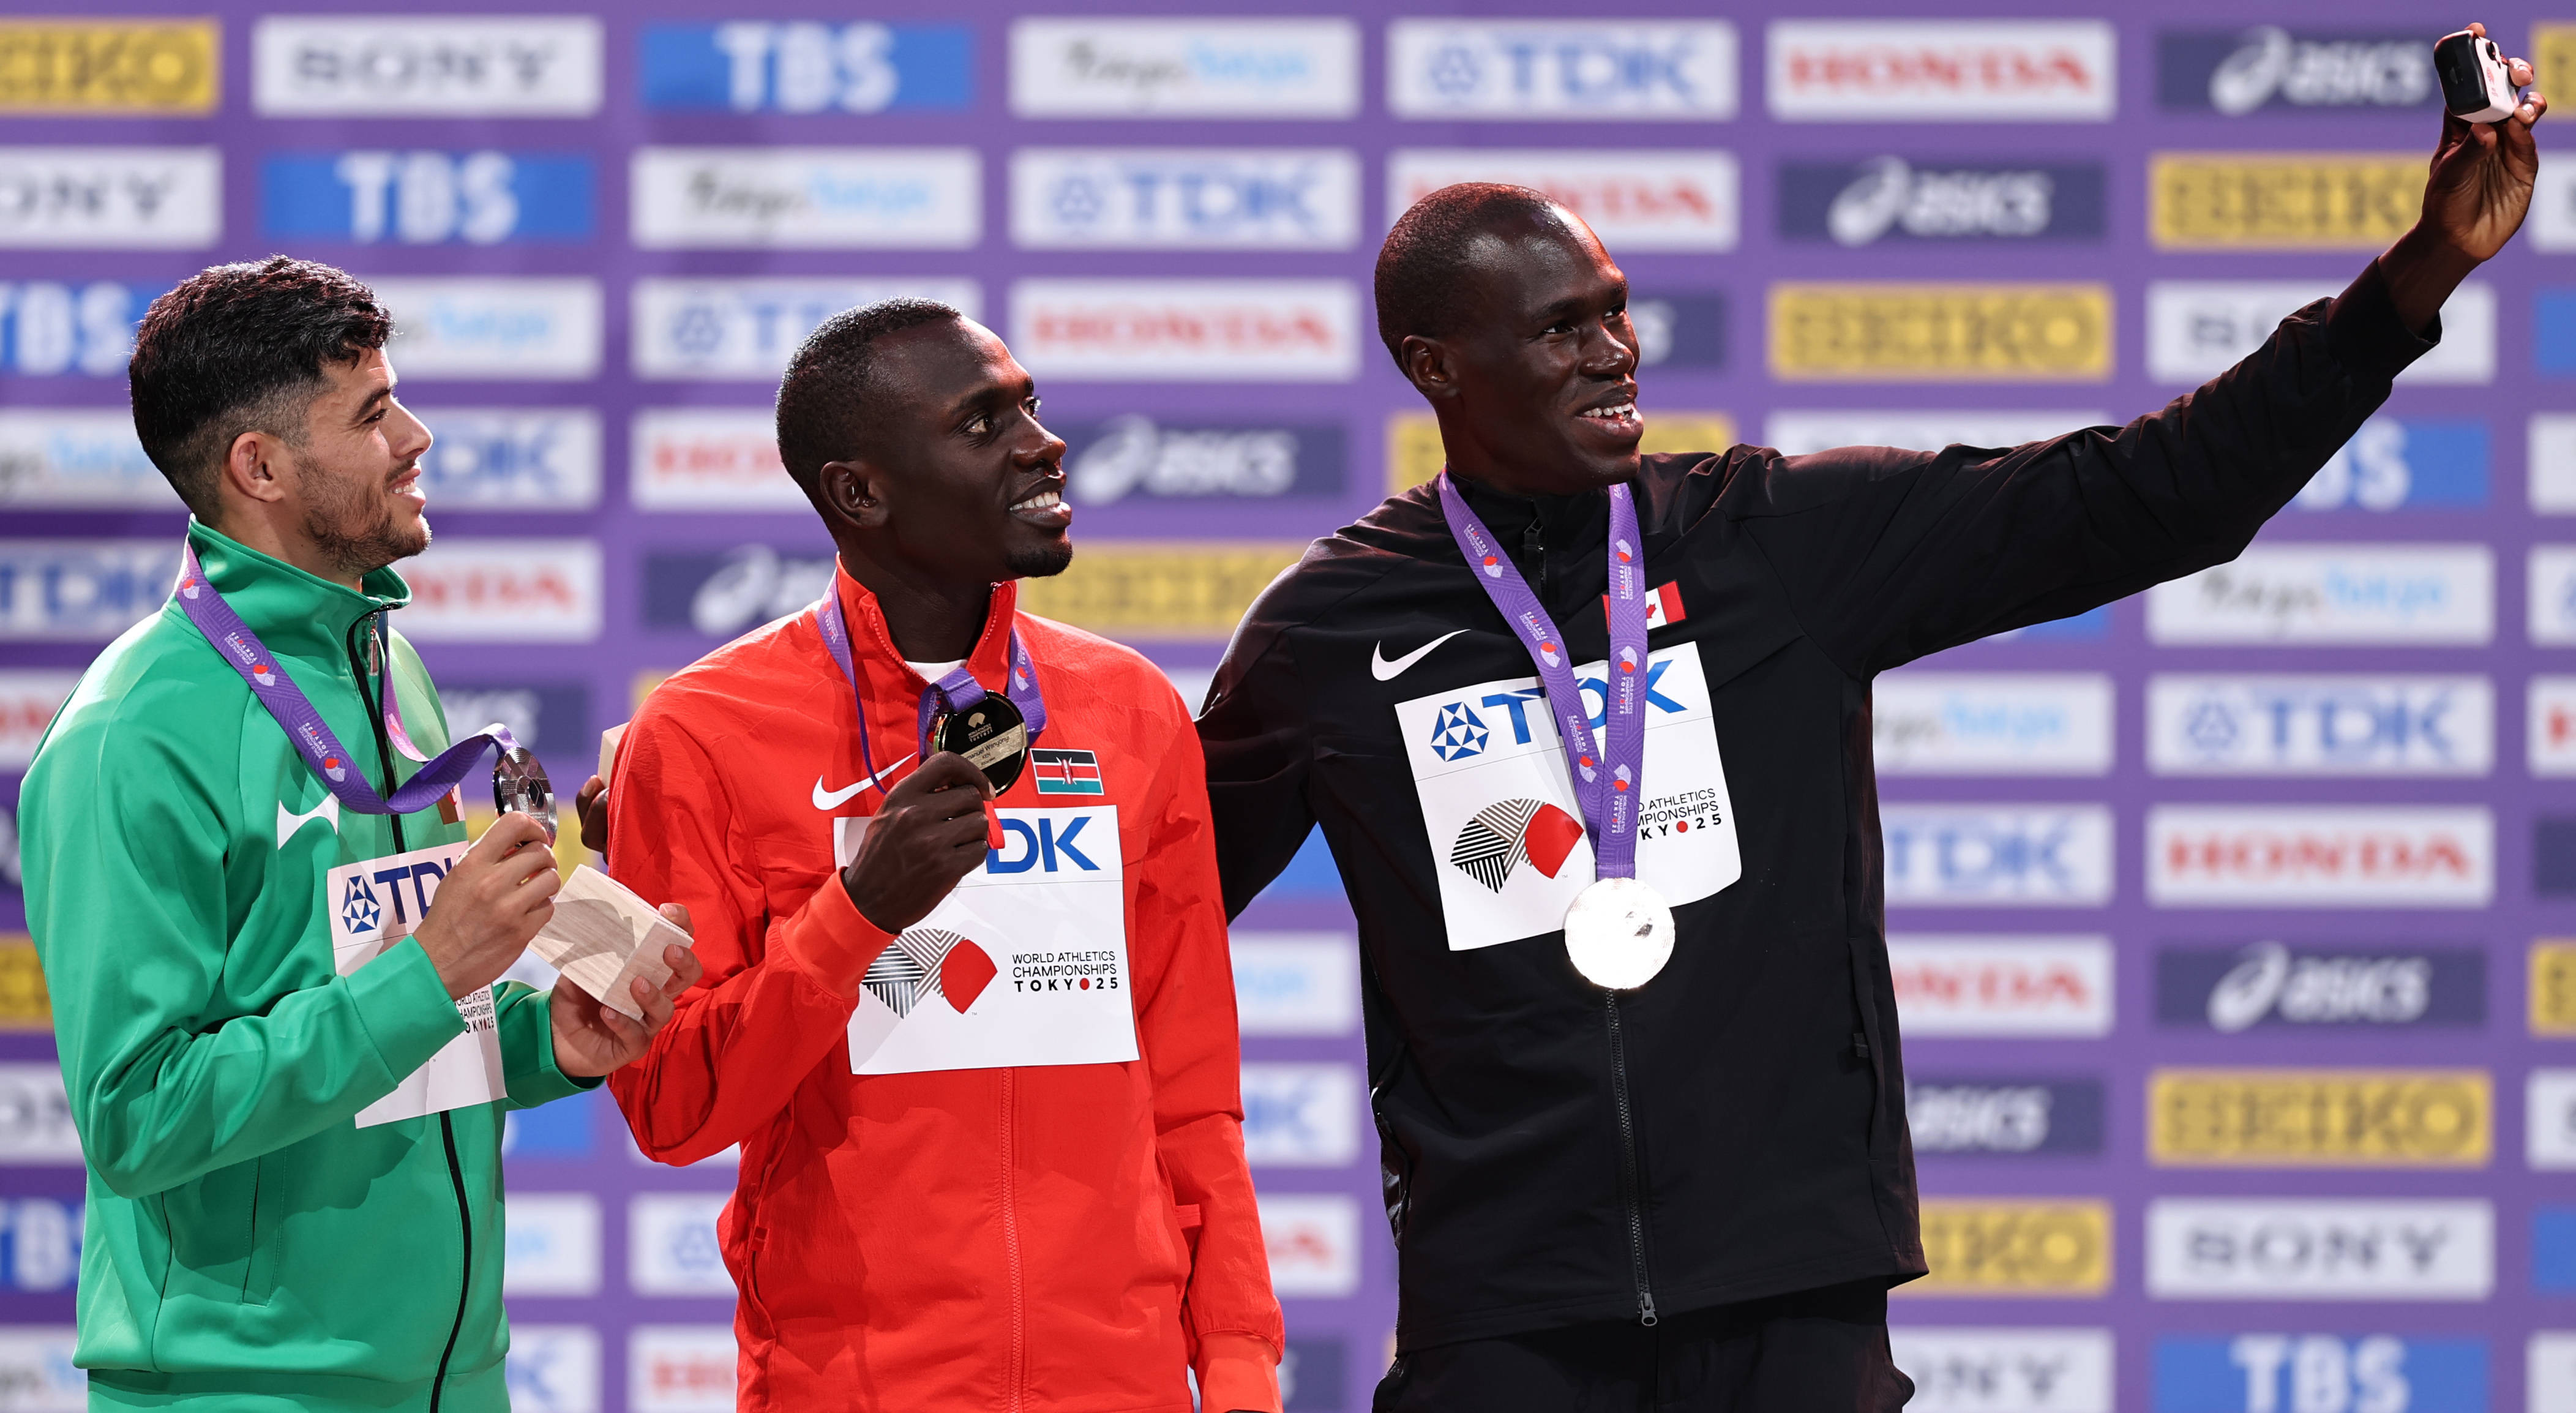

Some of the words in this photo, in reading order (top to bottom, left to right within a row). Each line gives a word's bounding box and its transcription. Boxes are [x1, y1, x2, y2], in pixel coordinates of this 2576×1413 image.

[715, 24, 897, 113] TBS
[1492, 39, 1700, 104] TDK
[1784, 43, 2094, 96] HONDA
[0, 173, 176, 222] ONY
[337, 153, 519, 242] TBS
[1117, 165, 1325, 231] TDK
[0, 282, 132, 375] BS
[1033, 306, 1337, 355] HONDA
[401, 566, 578, 616] NDA
[2252, 693, 2460, 759] TDK
[1649, 789, 1715, 810] ATHLETICS
[986, 816, 1101, 874] DK
[1641, 814, 1721, 840] KYO25
[2166, 830, 2470, 882] HONDA
[373, 856, 460, 924] TD
[1012, 953, 1054, 964] WORLD
[1058, 951, 1115, 962] ATHLETICS
[1013, 964, 1117, 978] CHAMPIONSHIPS
[455, 994, 472, 1006] ORLD
[473, 990, 490, 1004] ATHLETICS
[460, 1003, 492, 1019] HAMPIONSHIPS
[1896, 960, 2091, 1011] NDA
[2278, 955, 2432, 1021] asics
[2187, 1222, 2455, 1276] SONY
[2228, 1333, 2413, 1412] TBS
